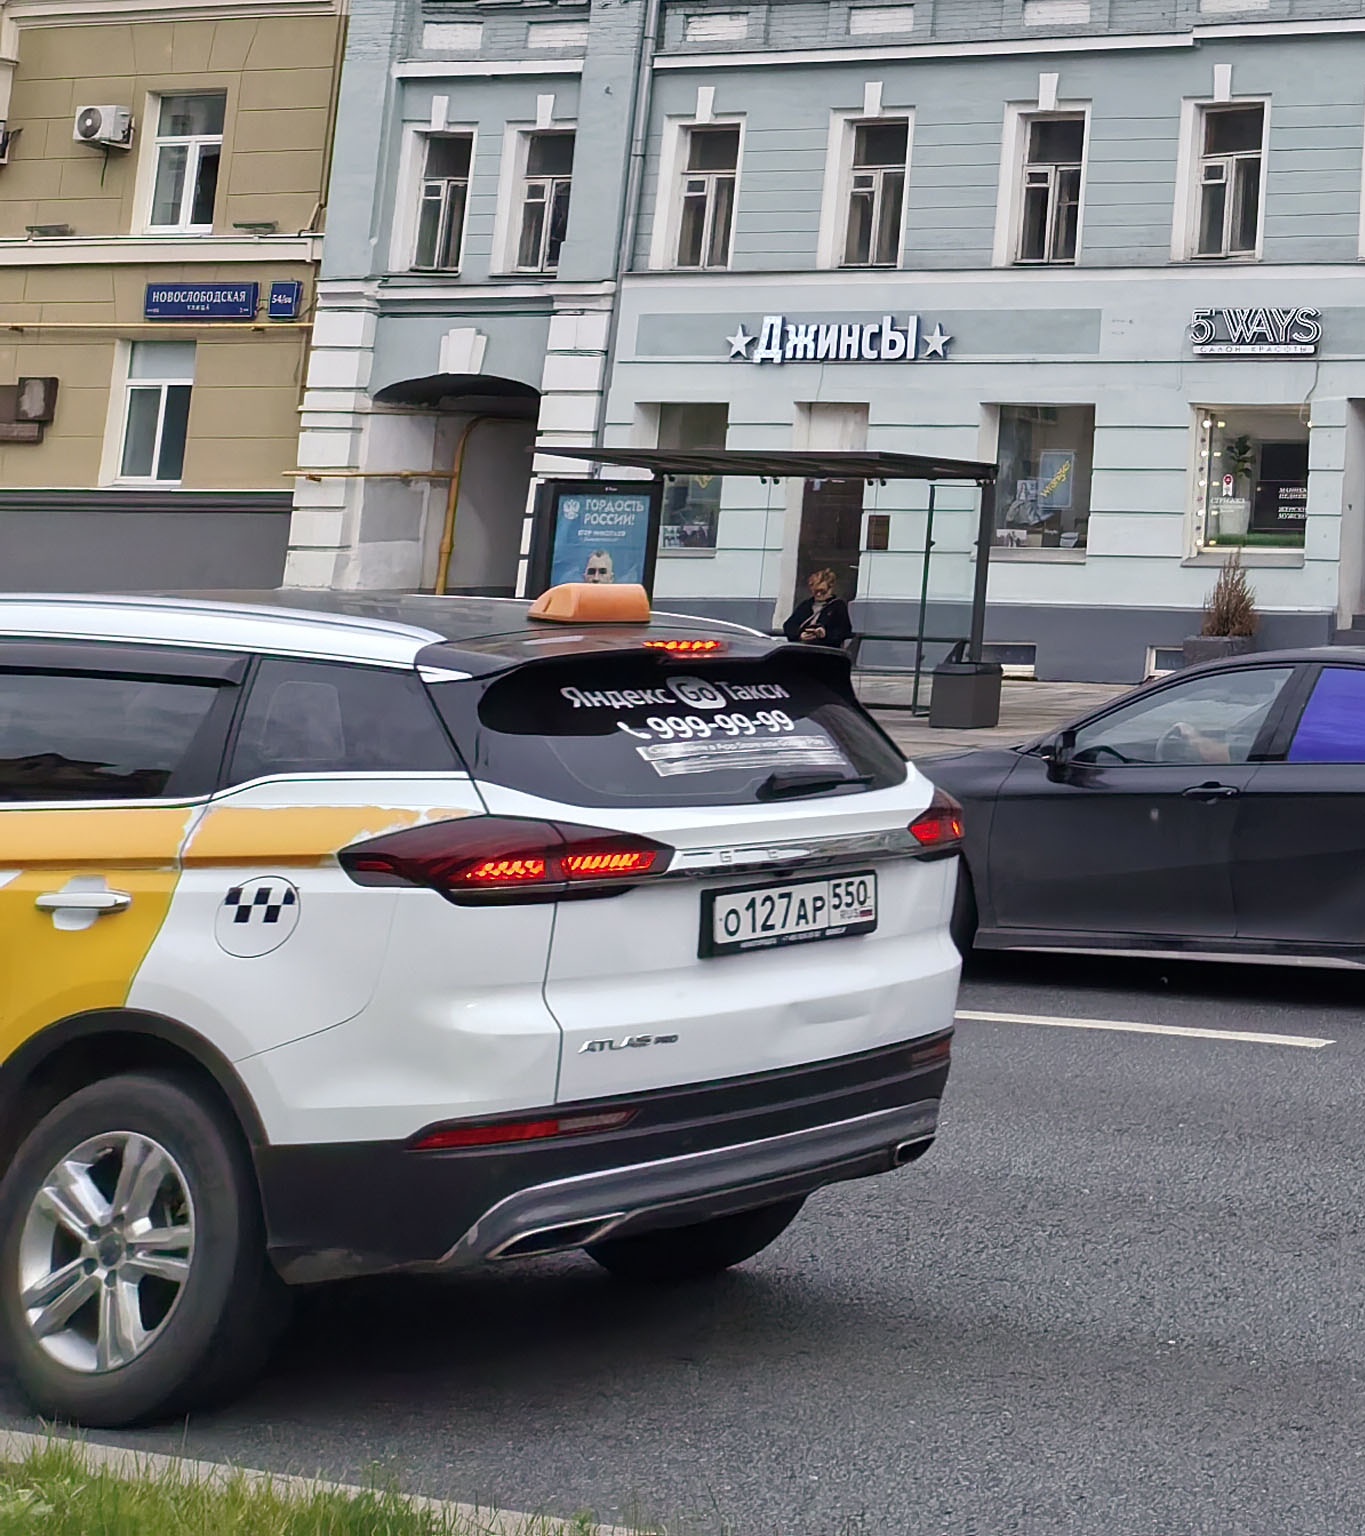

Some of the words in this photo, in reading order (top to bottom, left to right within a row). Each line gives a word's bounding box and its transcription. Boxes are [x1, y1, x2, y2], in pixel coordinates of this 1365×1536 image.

[152, 291, 247, 304] НОВОСЛОБОДСКАЯ
[1190, 308, 1216, 344] 5
[1222, 306, 1322, 344] WAYS
[585, 499, 645, 513] ГОРДОСТЬ
[583, 513, 636, 526] РОССИИ!
[560, 686, 677, 709] Яндекс
[714, 680, 791, 702] Такси
[646, 709, 796, 740] 999-99-99
[724, 891, 826, 938] О127АР
[832, 879, 869, 911] 550
[578, 1033, 653, 1055] ATLAS
